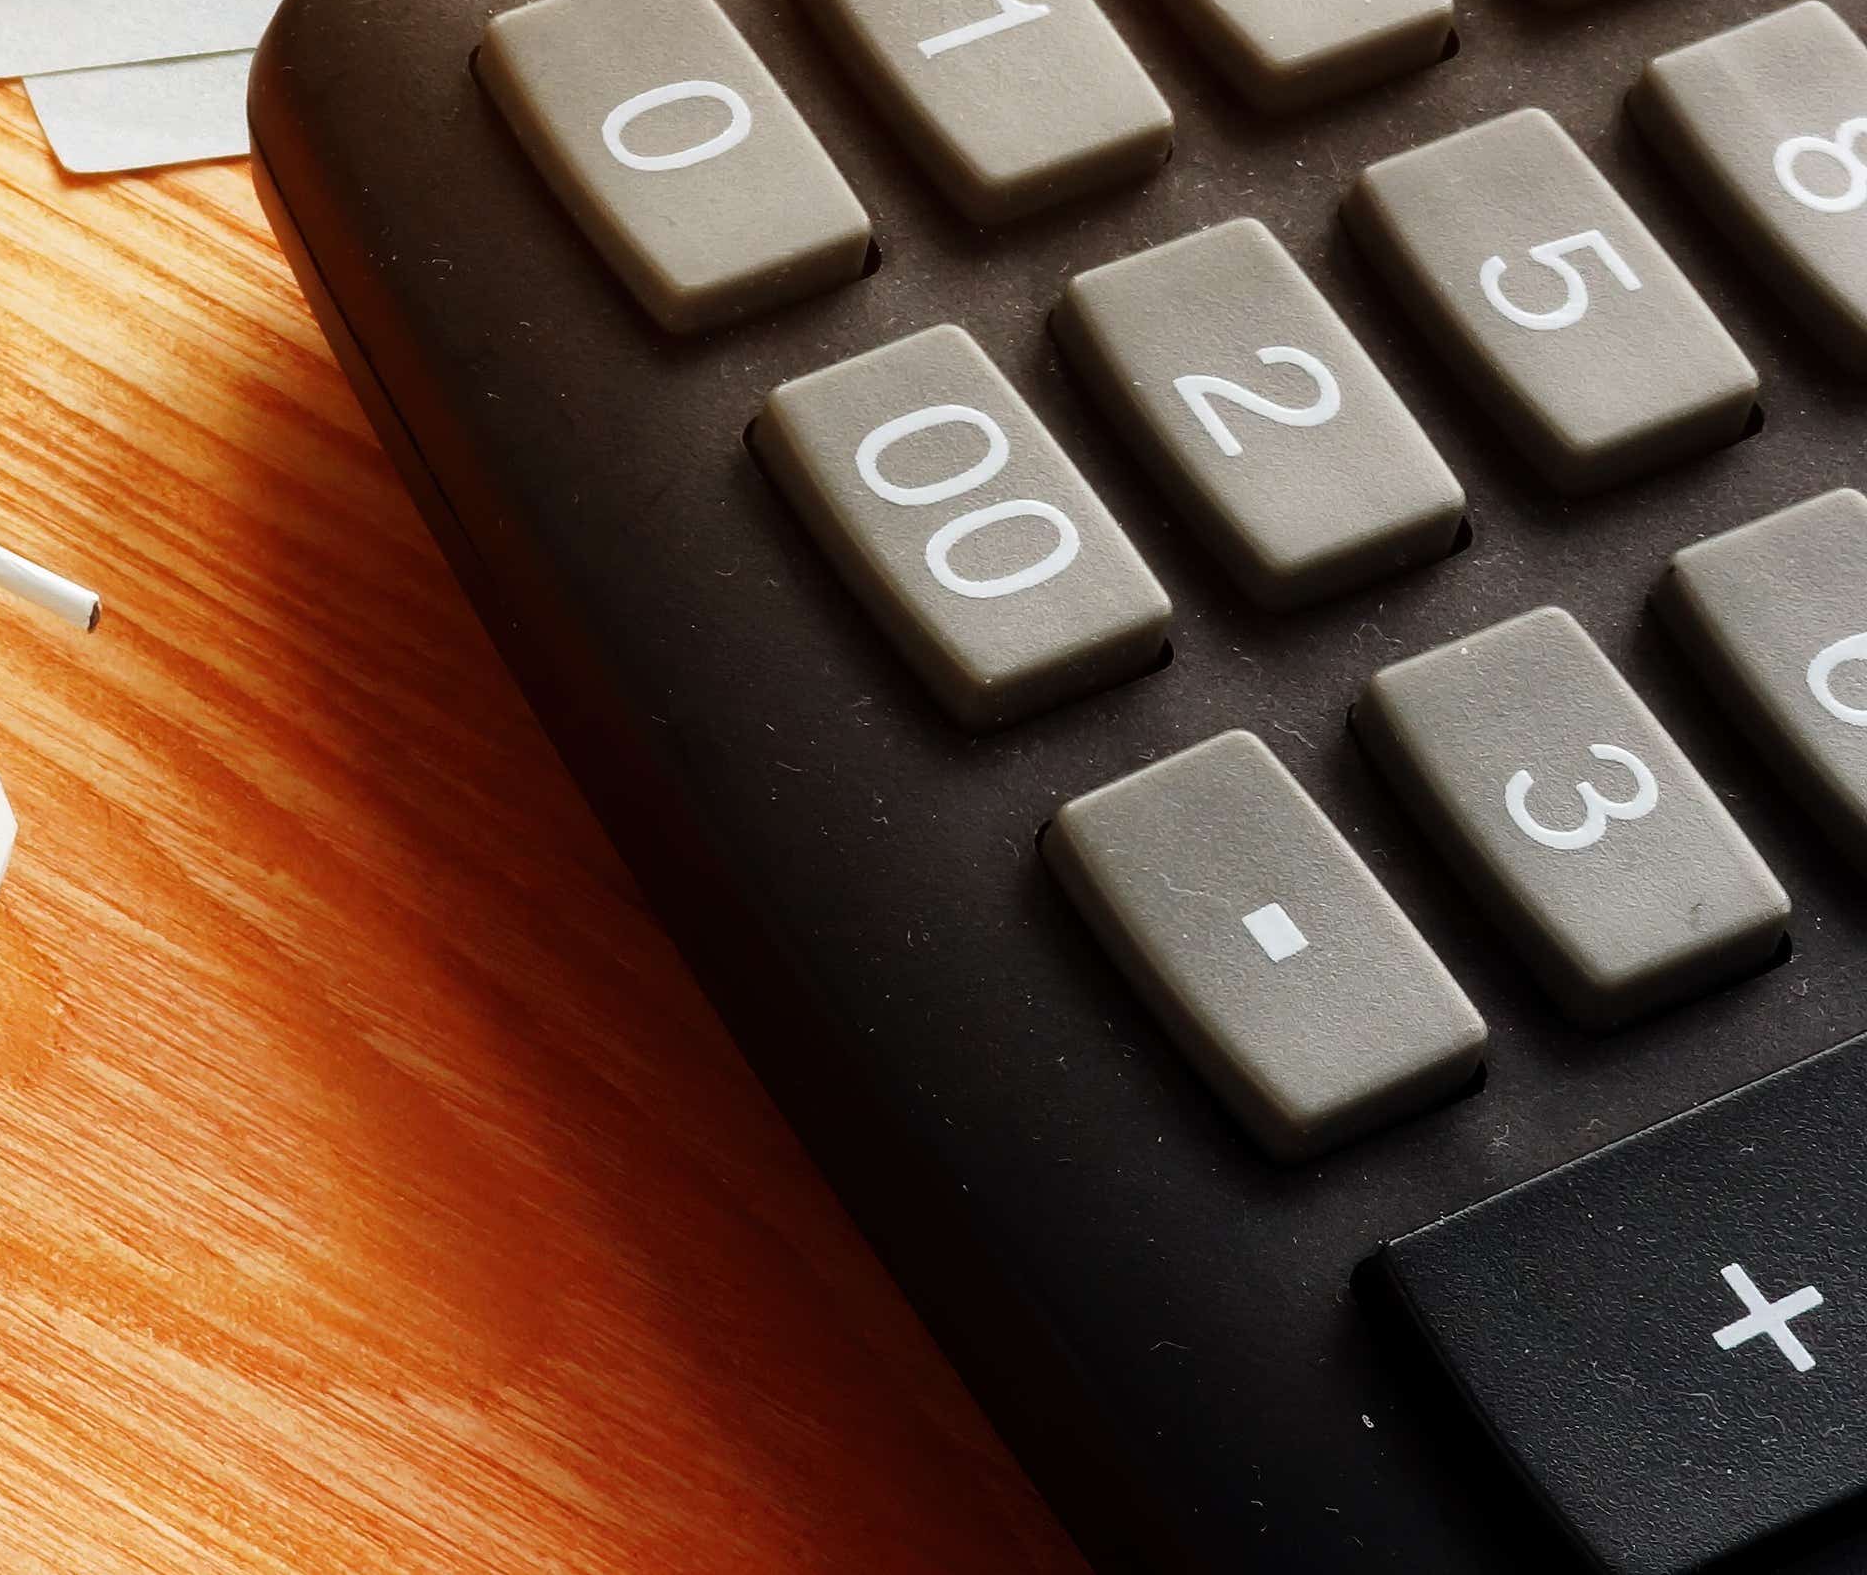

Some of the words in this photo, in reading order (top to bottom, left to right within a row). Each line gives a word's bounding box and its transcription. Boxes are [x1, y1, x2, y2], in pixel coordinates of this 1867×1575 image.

[600, 79, 752, 172] 0
[1480, 229, 1643, 331] 5
[1172, 345, 1342, 457] 2
[854, 403, 1082, 599] 00
[1504, 742, 1660, 851] 3
